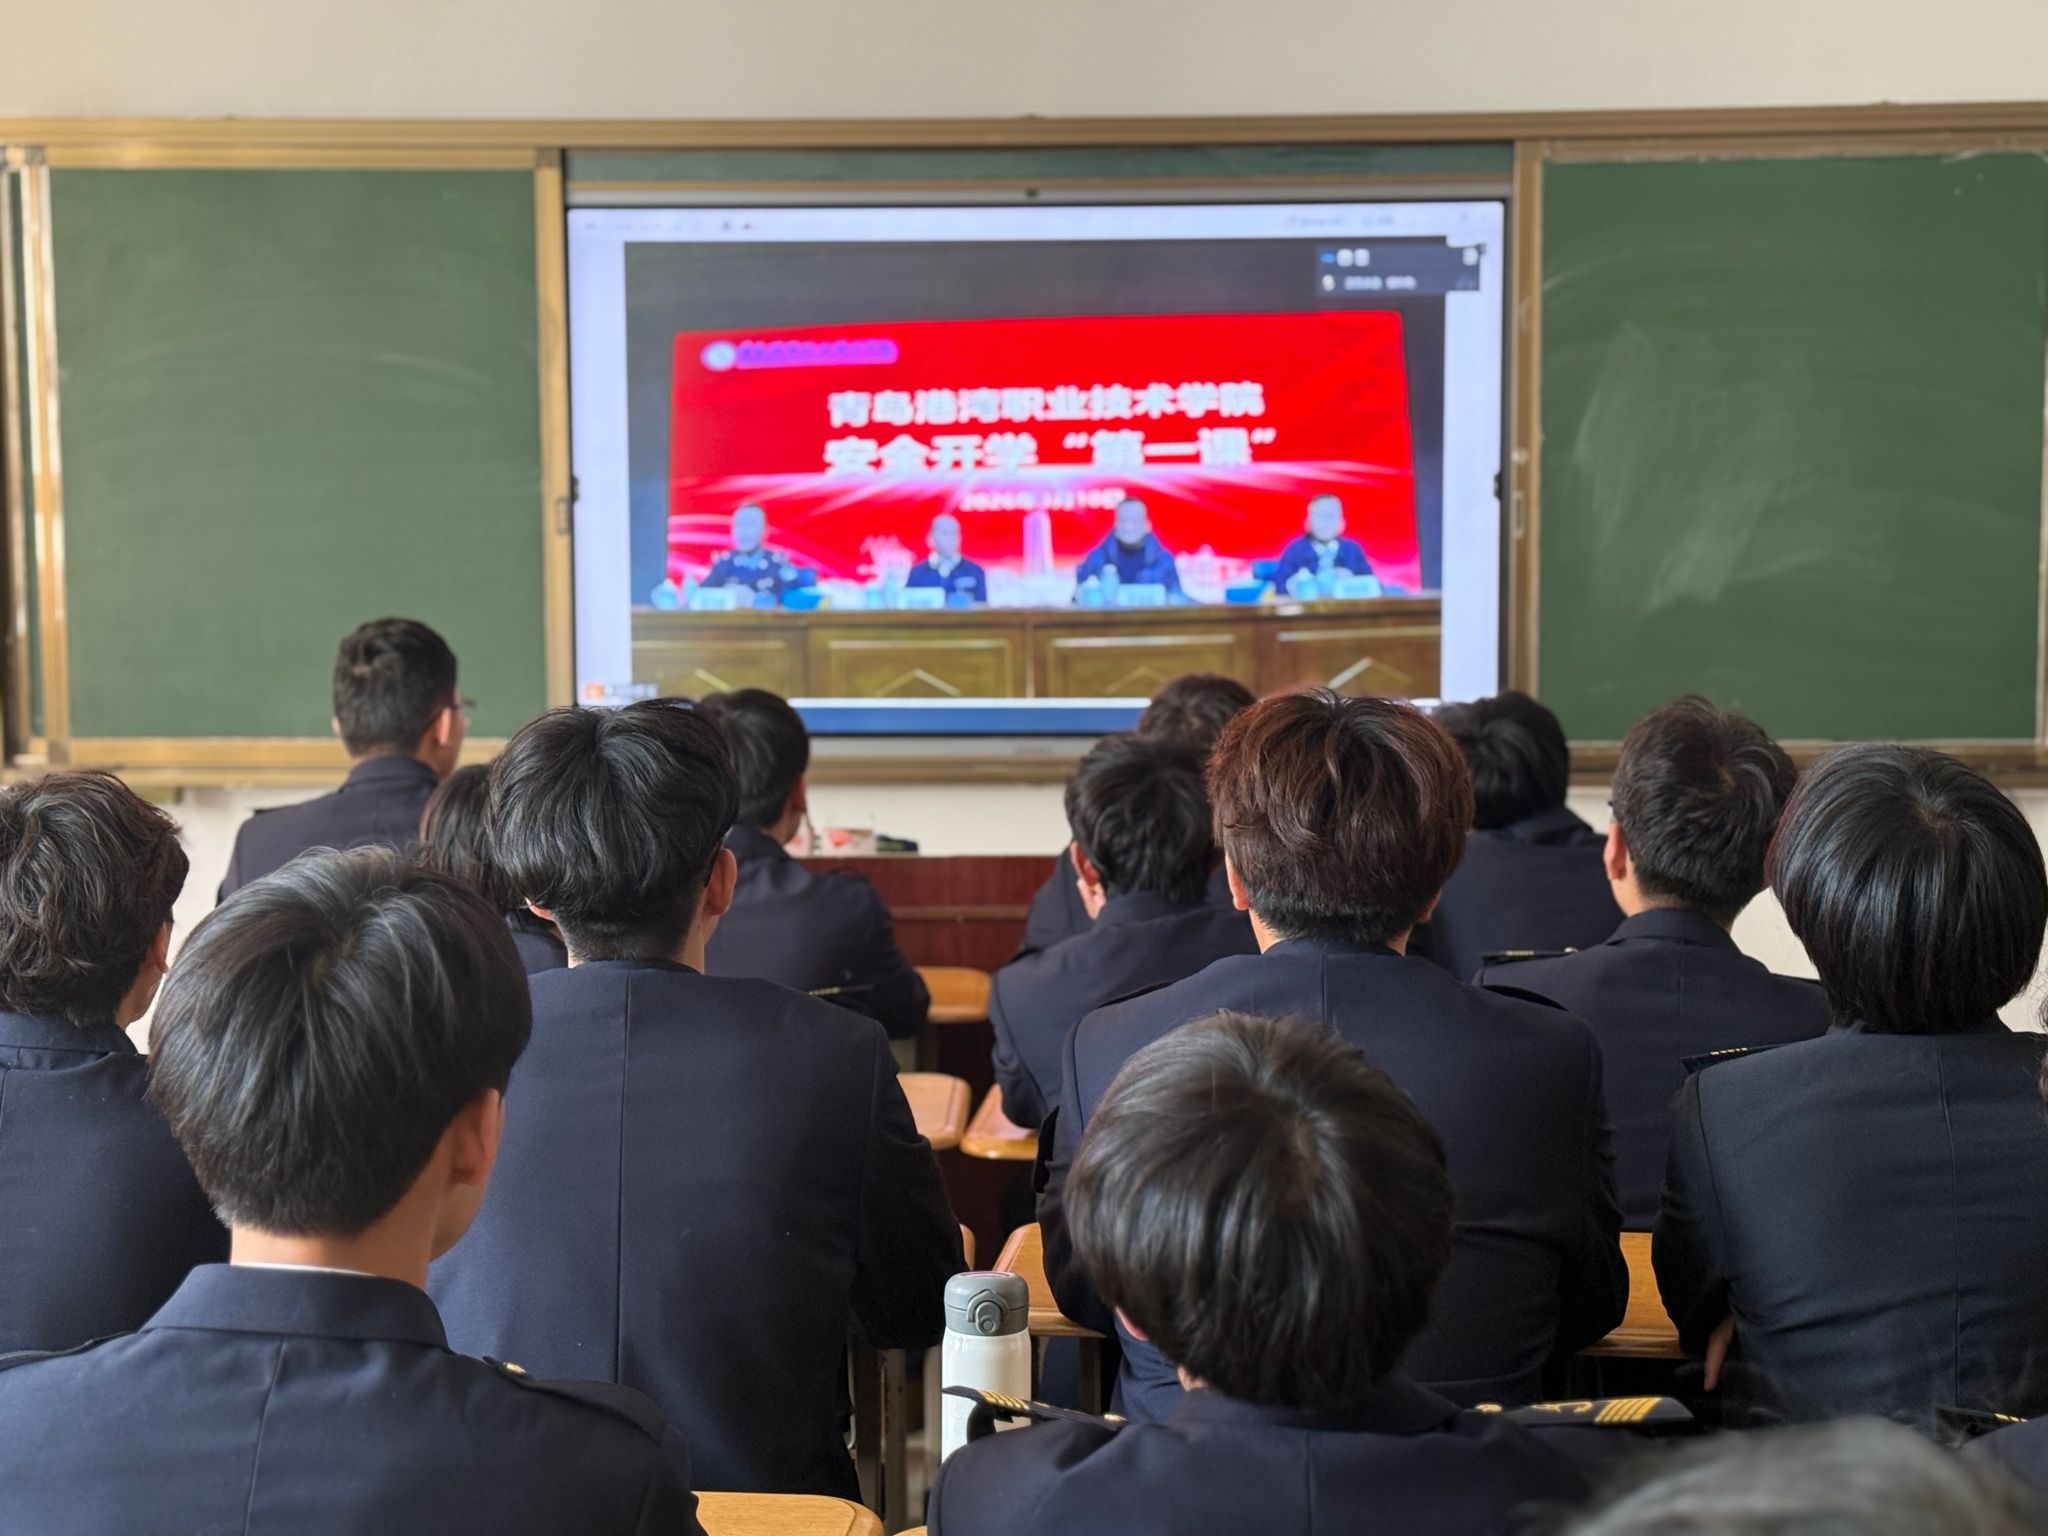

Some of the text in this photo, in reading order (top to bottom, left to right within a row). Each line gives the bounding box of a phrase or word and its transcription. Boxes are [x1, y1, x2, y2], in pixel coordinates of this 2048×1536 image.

[827, 381, 1266, 428] 青岛港湾职业技术学院
